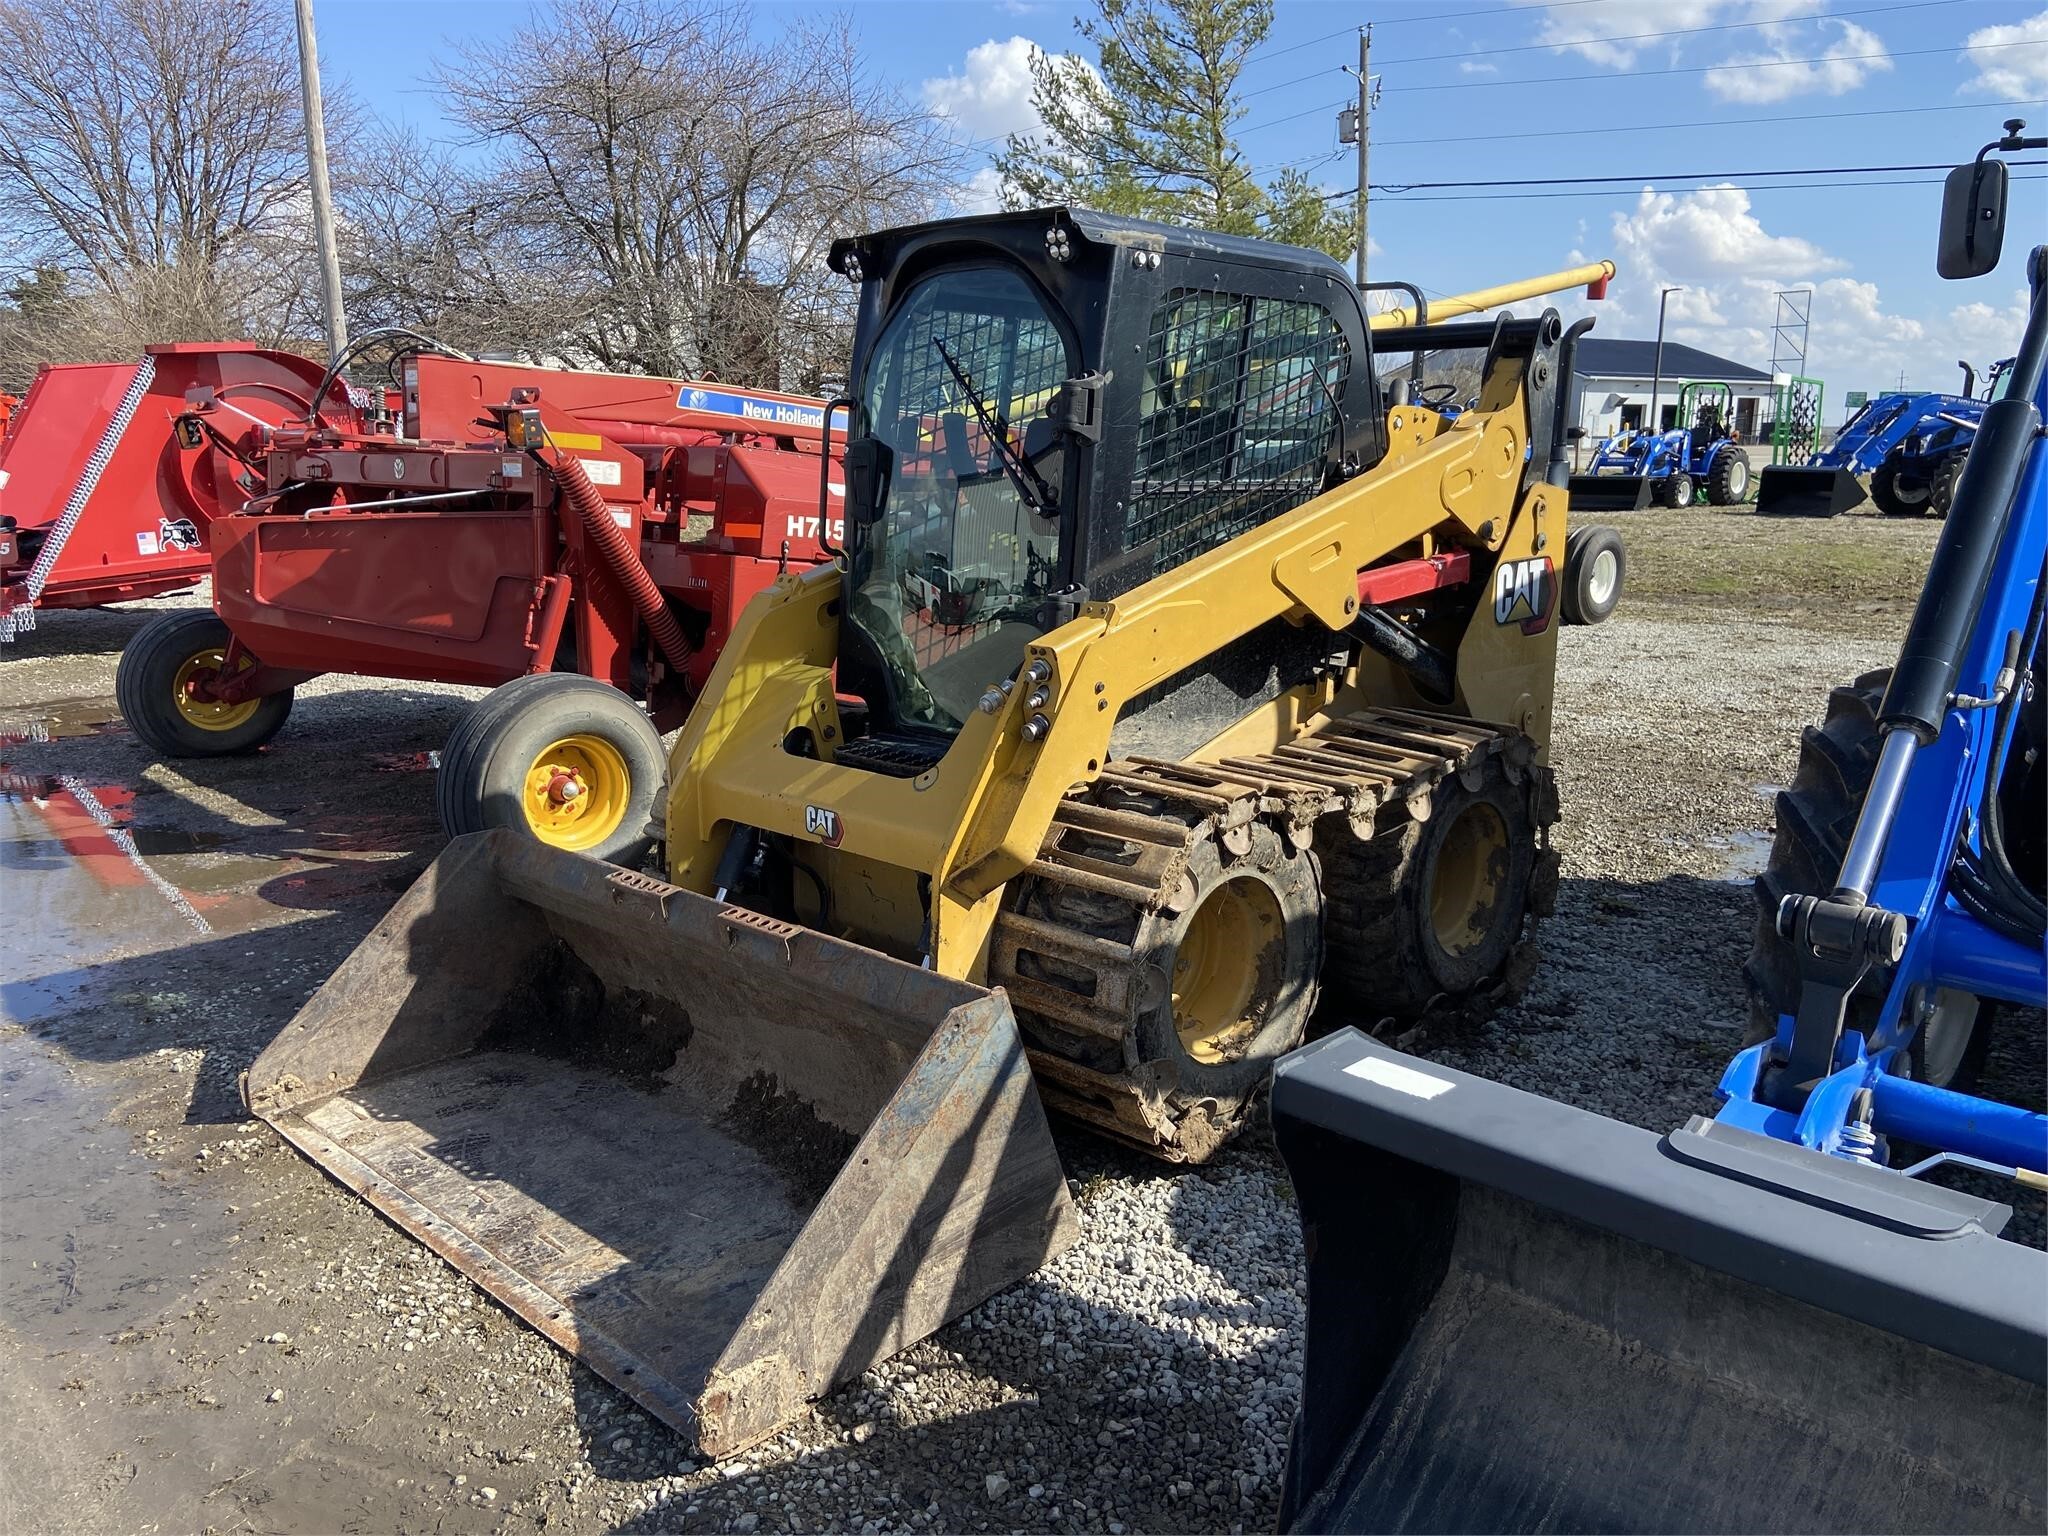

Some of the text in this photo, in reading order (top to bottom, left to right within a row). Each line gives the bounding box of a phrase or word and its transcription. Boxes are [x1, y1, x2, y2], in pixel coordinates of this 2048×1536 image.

[743, 401, 824, 426] New Holland
[1496, 558, 1545, 624] CAT
[806, 806, 835, 838] CAT
